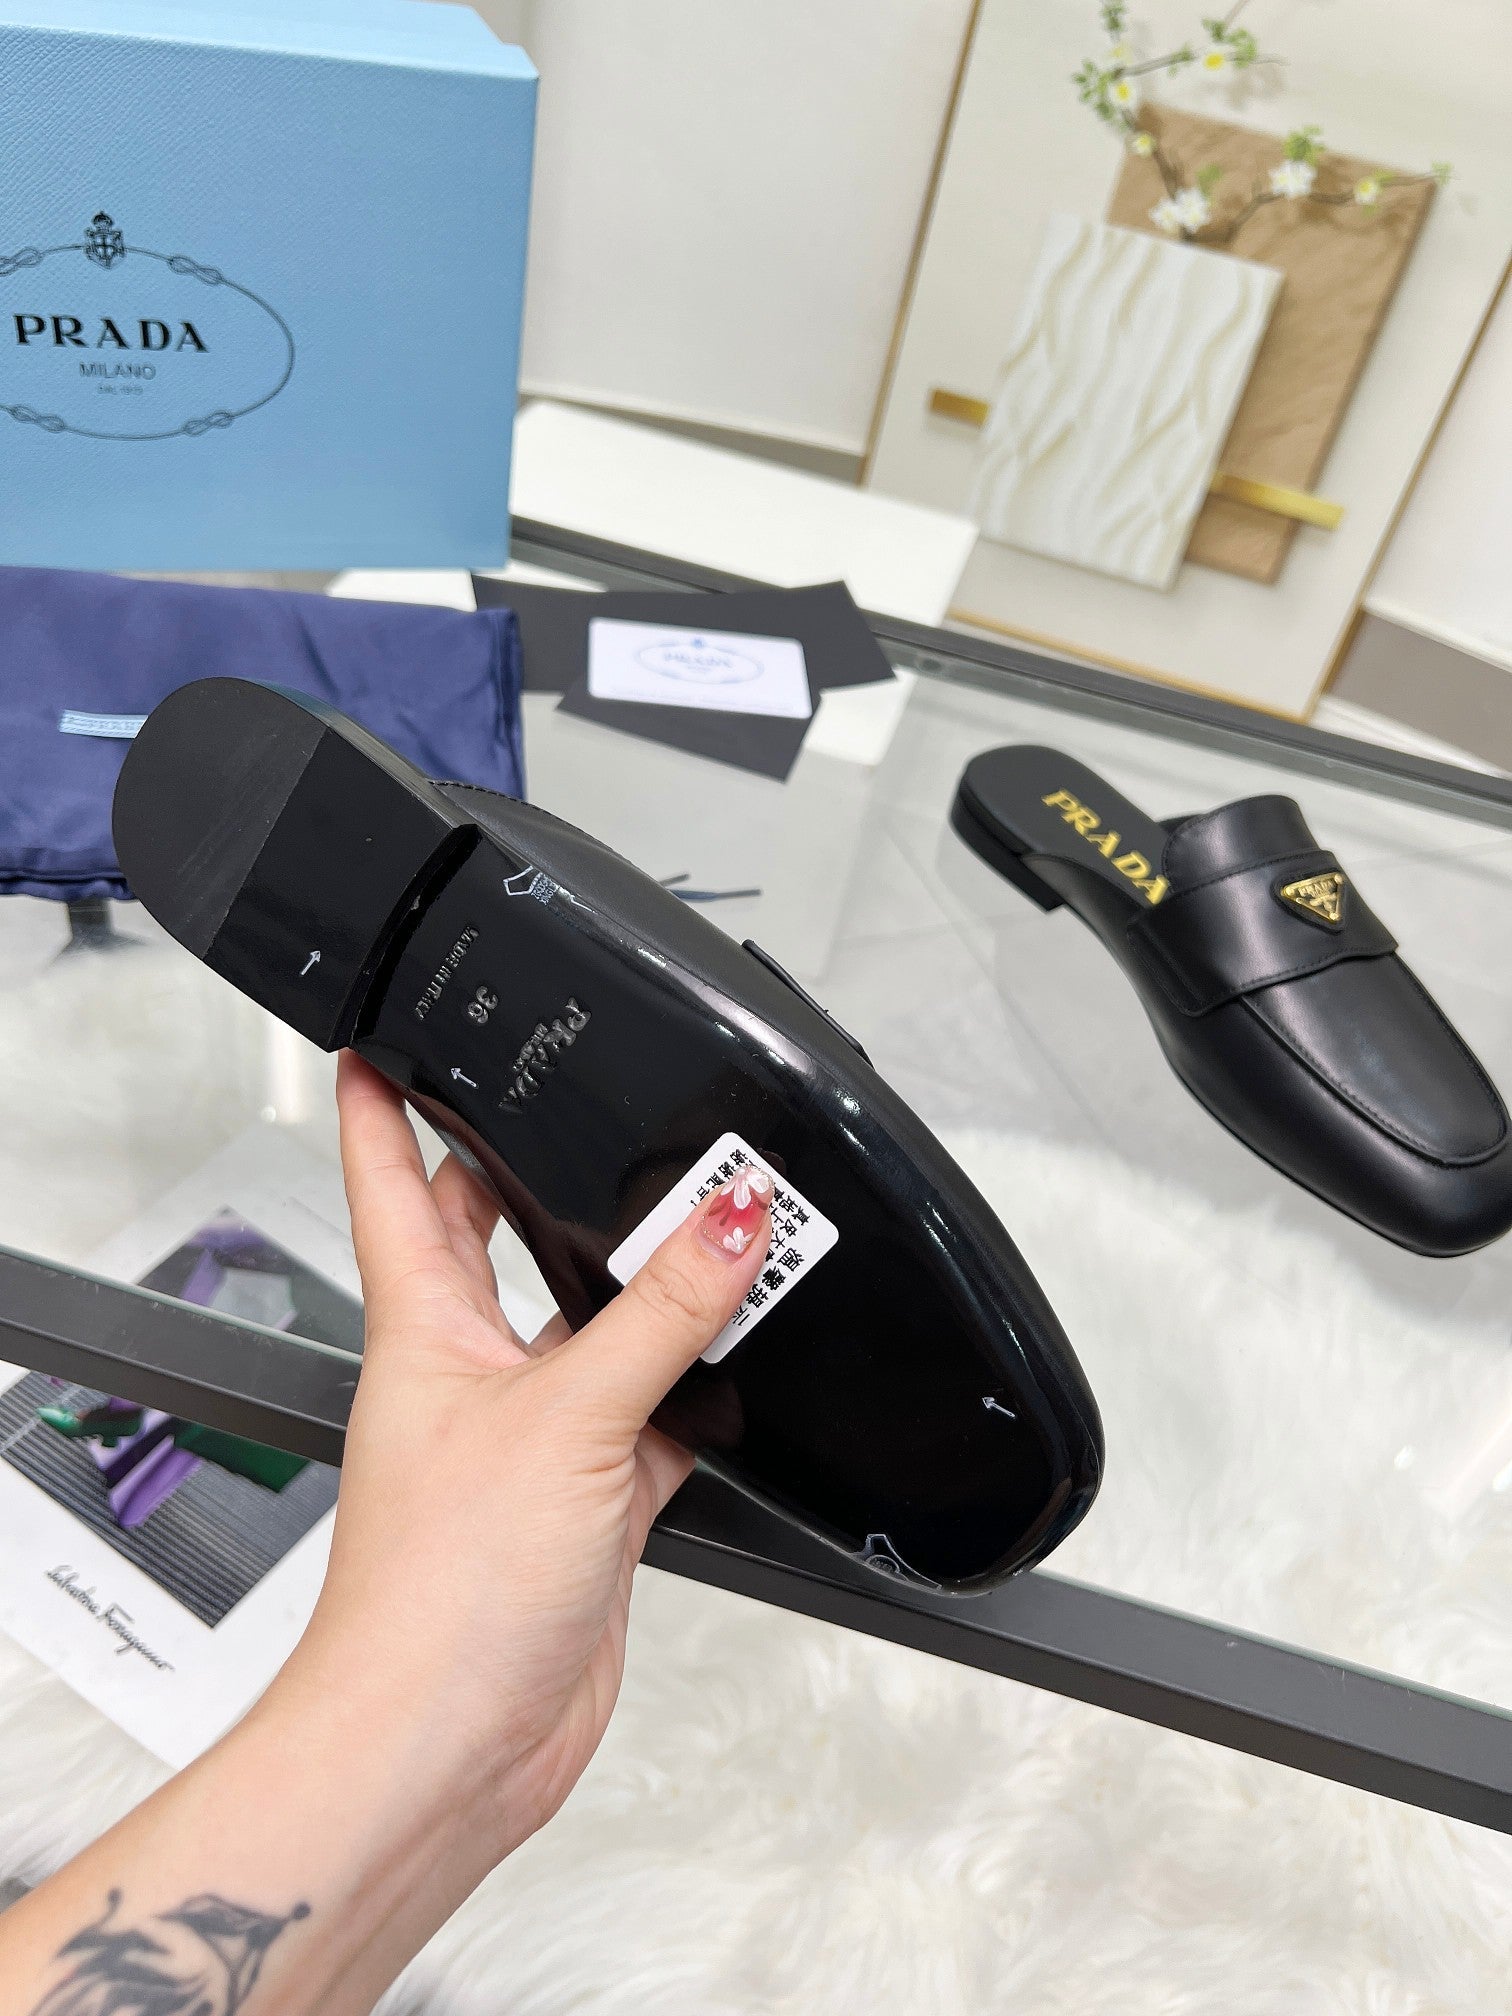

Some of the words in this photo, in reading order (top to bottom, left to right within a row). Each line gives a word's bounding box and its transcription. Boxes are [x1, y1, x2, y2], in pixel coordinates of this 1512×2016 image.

[13, 313, 210, 353] PRADA
[79, 361, 157, 380] MILANO
[1040, 788, 1169, 905] PRADA
[445, 925, 480, 968] MADE
[413, 980, 444, 1021] ITALY
[467, 985, 499, 1025] 36
[498, 997, 591, 1114] PRADA
[732, 1247, 805, 1327] 温馨提示
